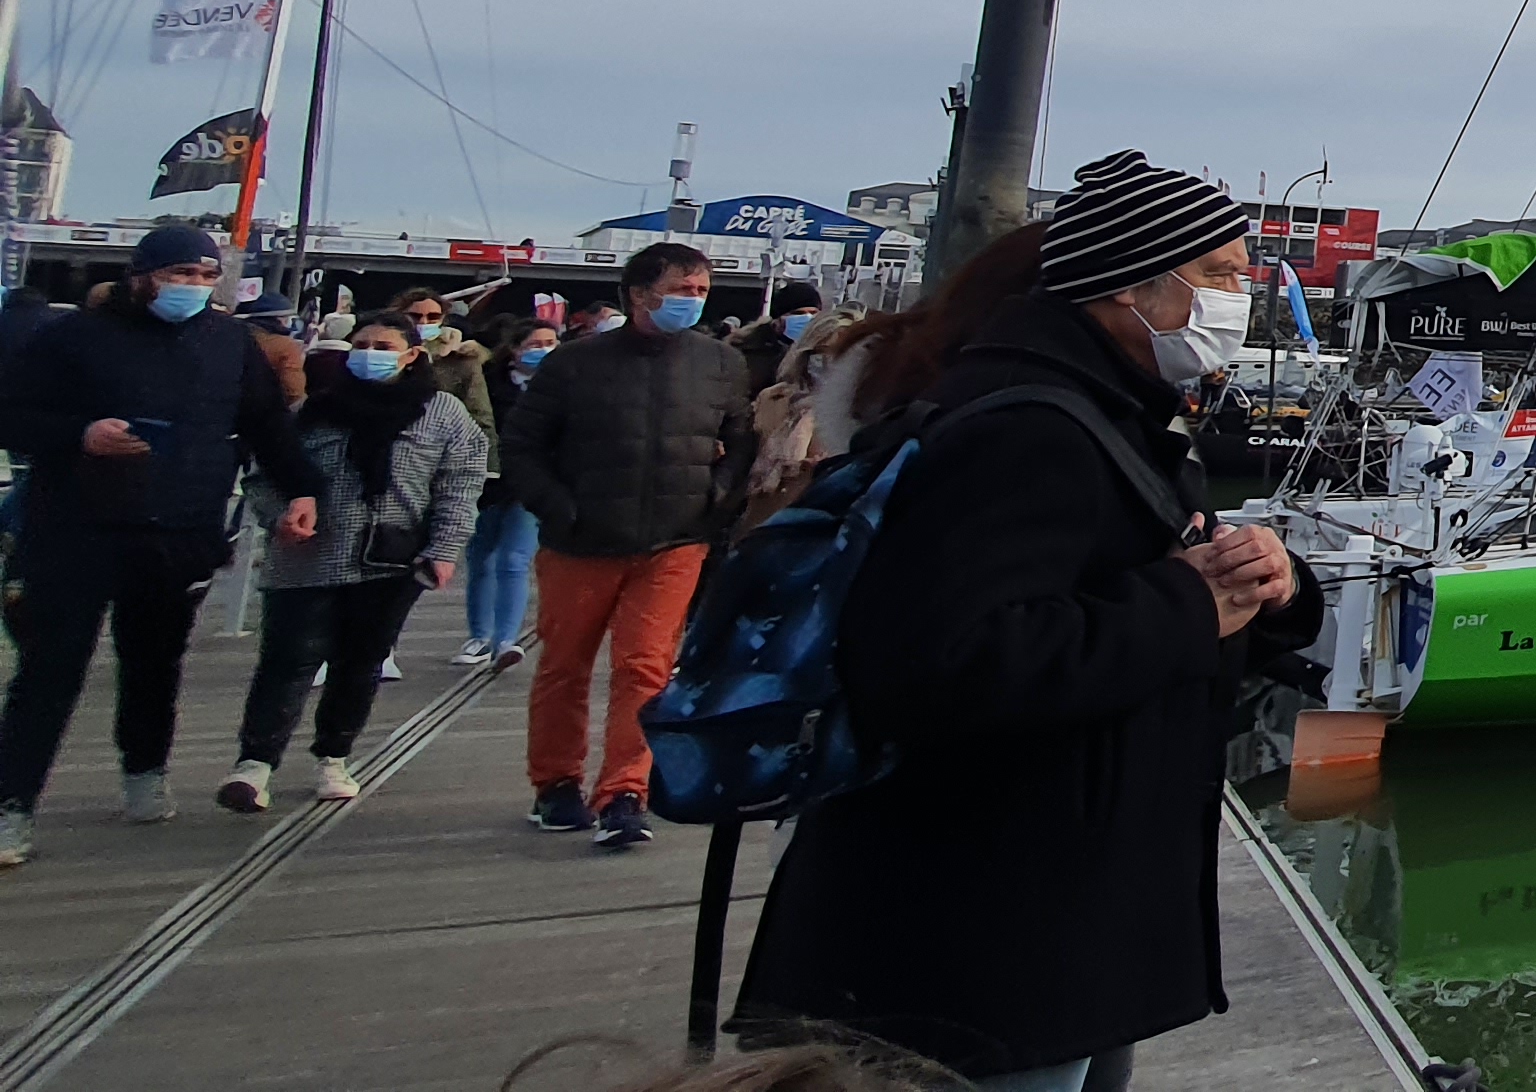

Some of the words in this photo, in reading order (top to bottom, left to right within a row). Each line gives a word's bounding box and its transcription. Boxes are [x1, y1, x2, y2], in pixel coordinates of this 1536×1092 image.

[1410, 311, 1467, 336] PURE
[1453, 612, 1488, 630] par
[1499, 629, 1534, 652] La
